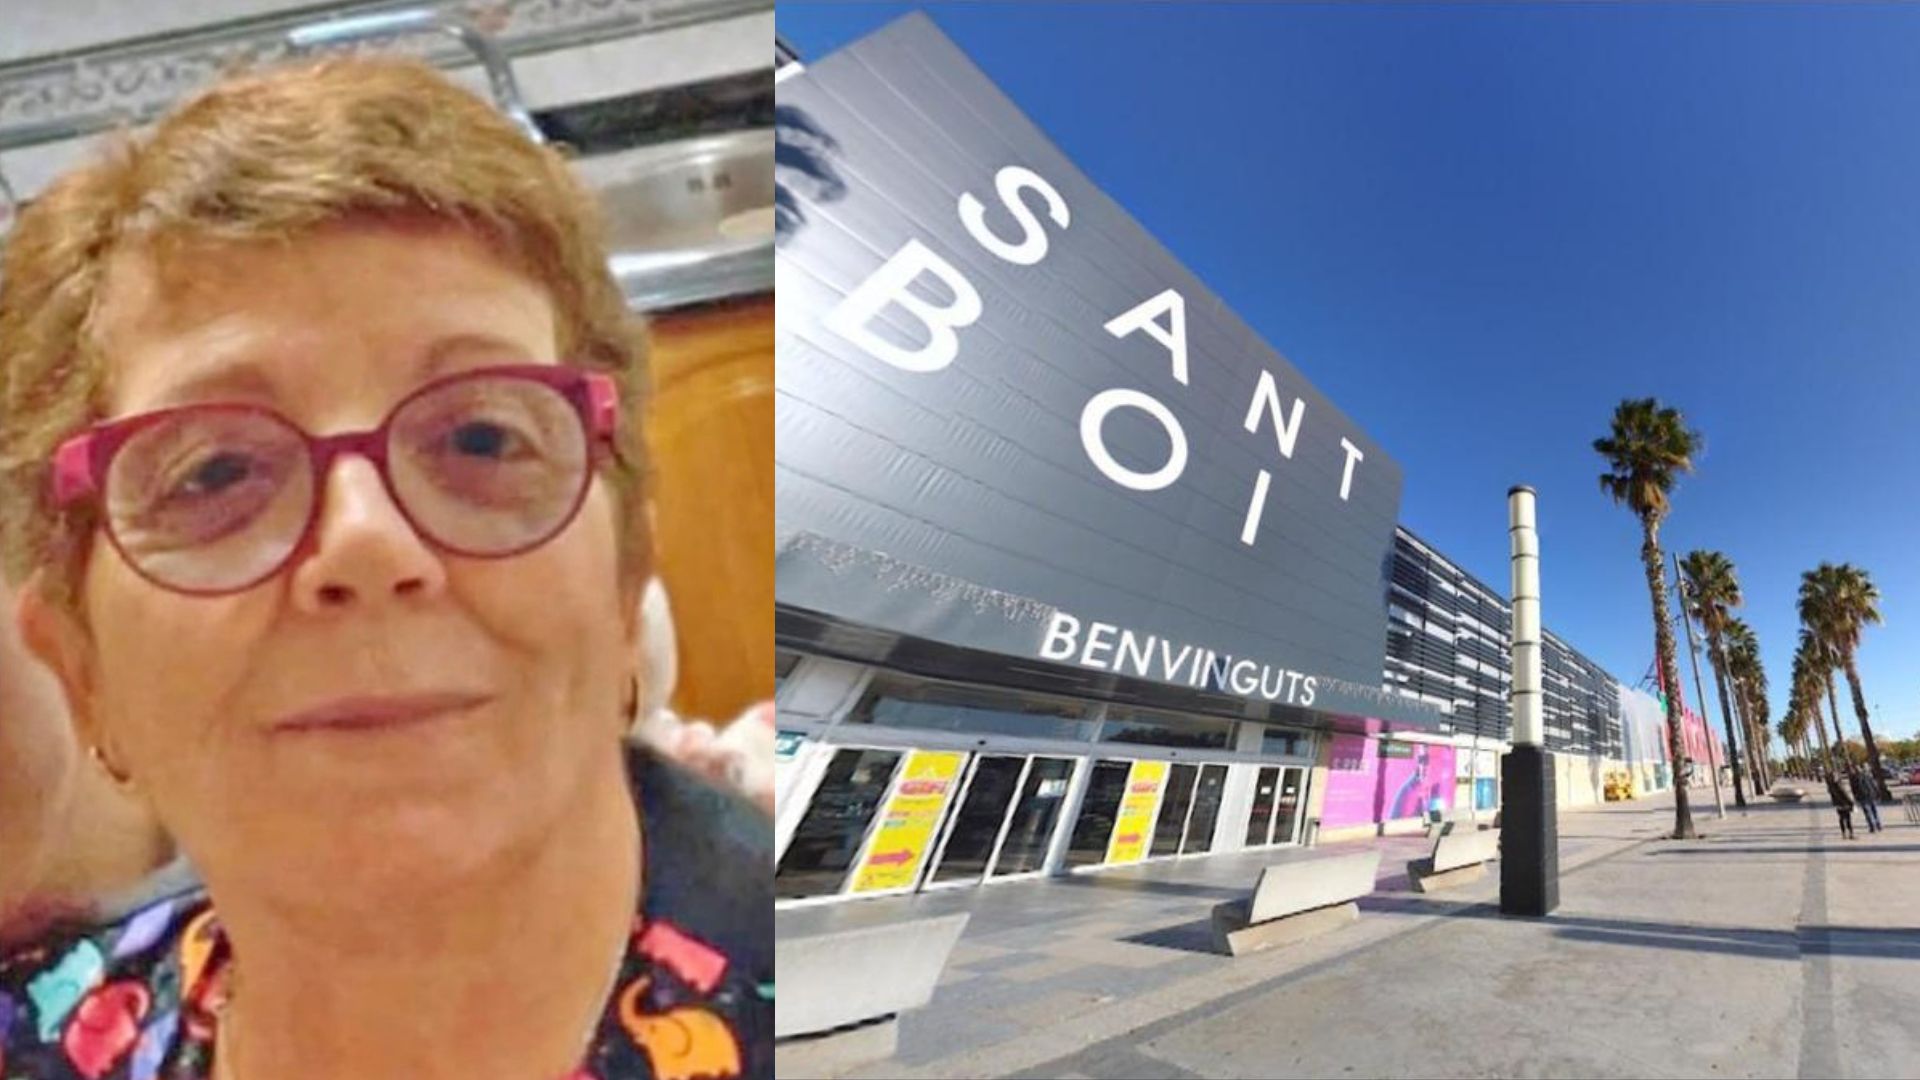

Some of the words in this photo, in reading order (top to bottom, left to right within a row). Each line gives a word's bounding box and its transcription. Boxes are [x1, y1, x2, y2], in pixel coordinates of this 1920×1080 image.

[826, 240, 1271, 545] BOI
[959, 166, 1362, 500] SANT
[1040, 614, 1317, 707] BENVINGUTS
